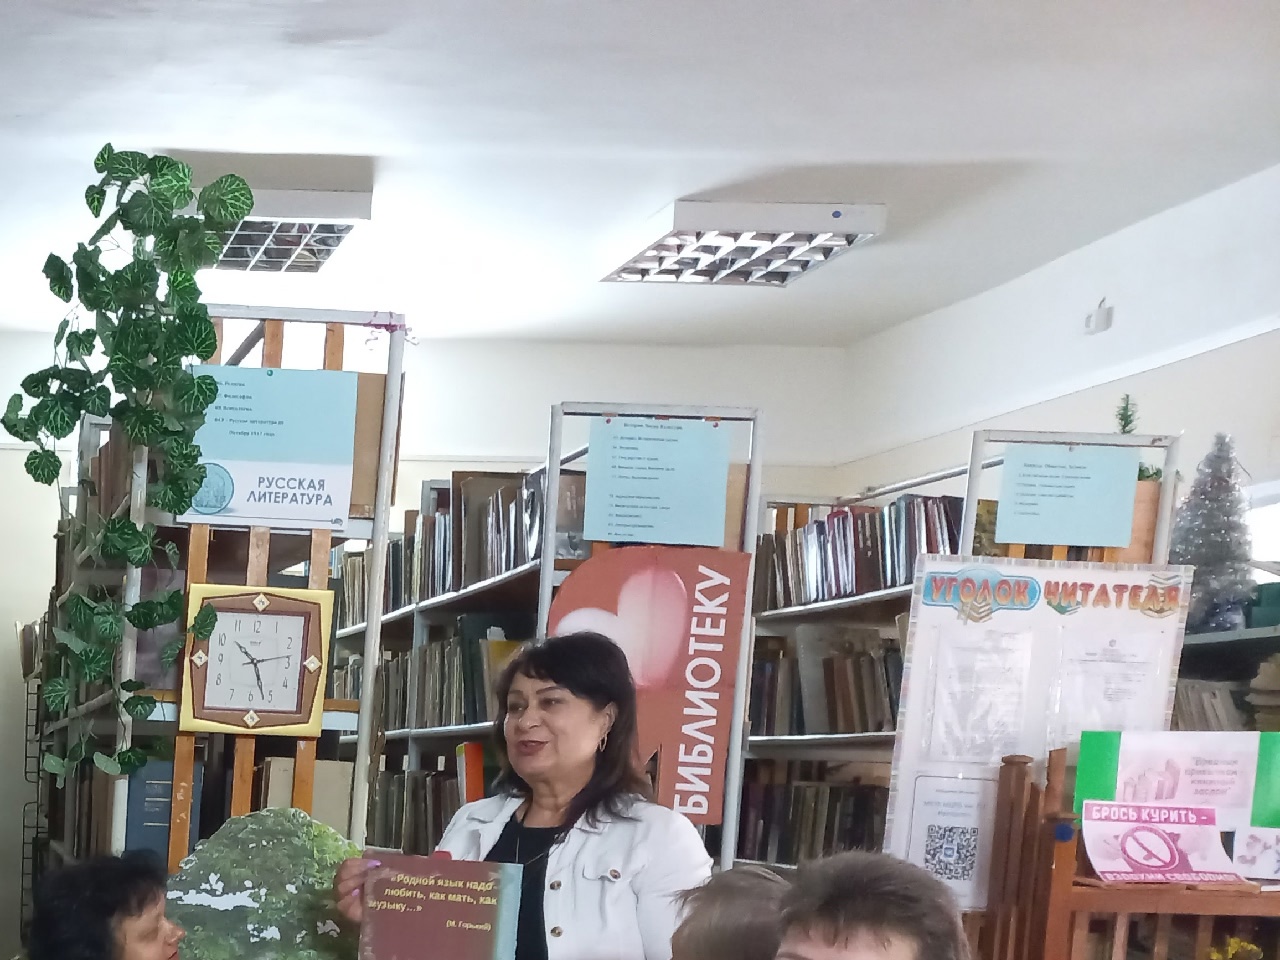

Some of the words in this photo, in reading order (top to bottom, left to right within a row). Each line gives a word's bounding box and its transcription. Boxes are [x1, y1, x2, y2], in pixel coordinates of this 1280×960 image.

[258, 476, 325, 491] РУССКАЯ
[246, 490, 333, 506] ЛИТЕРАТУРА
[930, 576, 1031, 606] УГОЛОК
[1043, 580, 1181, 611] ЧИТАТЕЛЯ
[235, 620, 242, 633] 11
[253, 620, 261, 633] 12
[218, 633, 226, 646] 10
[287, 637, 293, 649] 2
[218, 653, 223, 664] 9
[285, 656, 291, 669] 3
[216, 673, 222, 686] 8
[283, 677, 288, 689] 4
[229, 688, 235, 700] 7
[248, 690, 254, 702] 6
[673, 564, 731, 815] БИБЛИОТЕКУ
[268, 690, 273, 703] 5
[1091, 806, 1138, 821] БРОСЬ
[1142, 808, 1197, 824] КУРИТЬ
[437, 878, 464, 889] язык
[384, 887, 426, 900] любить,
[429, 892, 446, 901] как
[448, 893, 477, 905] мать,
[479, 896, 498, 905] как
